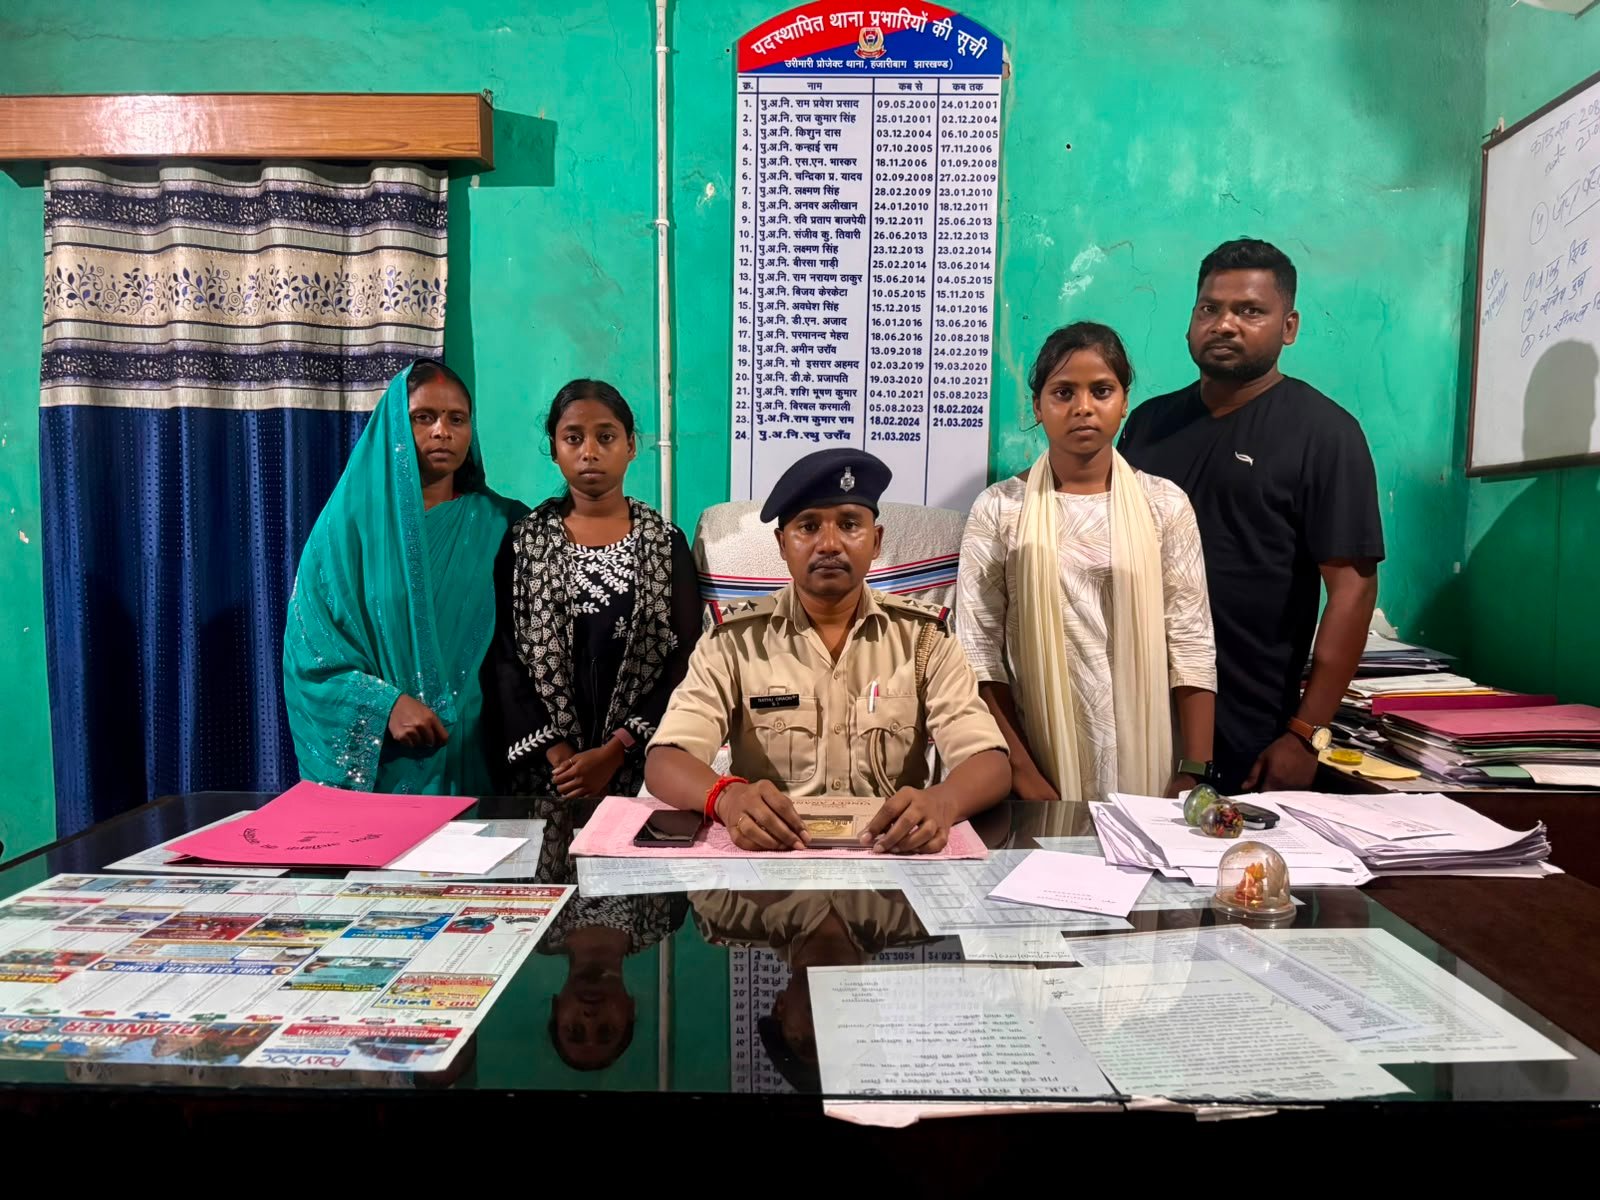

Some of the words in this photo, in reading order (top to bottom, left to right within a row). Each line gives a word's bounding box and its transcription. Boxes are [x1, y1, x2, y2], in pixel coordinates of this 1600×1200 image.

[750, 14, 824, 54] पदस्थापित
[830, 11, 864, 28] थाना
[869, 8, 928, 32] प्रभारियों
[932, 18, 953, 40] की
[958, 30, 988, 59] सूची
[784, 58, 814, 68] उरीमारी
[816, 58, 843, 68] प्रोजेक्ट
[846, 59, 868, 69] थाना,
[870, 58, 907, 68] हजारीबाग
[914, 58, 953, 70] झारखण्ड)
[742, 81, 754, 91] क्र.
[807, 82, 822, 91] नाम
[898, 82, 912, 91] कब
[914, 80, 923, 91] से
[952, 82, 966, 92] कब
[968, 82, 984, 92] तक
[744, 100, 752, 108] 1.
[761, 96, 793, 111] पु.अ.नि.
[796, 100, 810, 108] राम
[813, 97, 834, 108] प्रवेश
[836, 100, 860, 108] प्रसाद
[877, 100, 936, 109] 09.05.2000
[942, 100, 997, 109] 24.01.2001
[743, 114, 752, 122] 2.
[760, 111, 793, 125] पु.अ.नि.
[795, 114, 812, 122] राज
[814, 114, 838, 126] कुमार
[839, 112, 856, 123] सिंह
[876, 114, 931, 123] 25.01.2001
[942, 115, 997, 124] 02.12.2004
[743, 128, 752, 137] 3.
[760, 126, 792, 140] पु.अ.नि.
[795, 126, 822, 140] किशुन
[824, 129, 842, 137] दास
[877, 129, 932, 138] 03.12.2004
[942, 130, 998, 138] 06.10.2005
[760, 140, 792, 154] पु.अ.नि.
[795, 140, 821, 153] कन्हाई
[823, 144, 838, 152] राम
[876, 144, 933, 153] 07.10.2005
[941, 144, 992, 153] 17.11.2006
[742, 158, 752, 166] 5.
[760, 155, 792, 169] पु.अ.नि.
[795, 158, 827, 168] एस.एन.
[830, 158, 857, 166] भास्कर
[876, 158, 927, 167] 18.11.2006
[941, 159, 997, 168] 01.09.2008
[742, 172, 751, 180] 6.
[760, 170, 792, 183] पु.अ.नि.
[828, 173, 838, 181] प्र.
[840, 173, 863, 181] यादव
[876, 173, 933, 182] 02.09.2008
[940, 174, 996, 182] 27.02.2009
[742, 186, 751, 195] 7.
[759, 184, 792, 198] पु.अ.नि.
[794, 187, 821, 195] लक्ष्मण
[823, 184, 840, 196] सिंह
[875, 187, 931, 196] 28.02.2009
[939, 188, 992, 196] 23.01.2010
[742, 201, 751, 209] 8.
[759, 197, 791, 212] पु.अ.नि.
[794, 202, 820, 210] अनवर
[822, 199, 858, 210] अलीखान
[874, 202, 929, 211] 24.01.2010
[940, 202, 988, 211] 18.12.2011
[742, 216, 751, 224] 9.
[759, 213, 791, 227] पु.अ.नि.
[794, 213, 808, 224] रवि
[810, 216, 832, 224] प्रताप
[834, 214, 866, 225] बाजपेयी
[875, 216, 923, 225] 19.12.2011
[939, 217, 992, 226] 25.06.2013
[739, 230, 754, 238] 10.
[758, 228, 791, 241] पु.अ.नि.
[793, 228, 818, 239] संजीव
[820, 231, 833, 242] कु.
[835, 228, 861, 239] तिवारी
[874, 231, 928, 240] 26.06.2013
[938, 232, 989, 240] 22.12.2013
[740, 245, 752, 253] 11.
[758, 242, 791, 256] पु.अ.नि.
[793, 245, 820, 253] लक्ष्मण
[822, 241, 839, 255] सिंह
[874, 246, 924, 254] 23.12.2013
[938, 246, 992, 255] 23.02.2014
[739, 273, 752, 281] 13.
[758, 270, 790, 284] पु.अ.नि.
[792, 274, 807, 282] राम
[809, 274, 838, 282] नरायण
[840, 274, 863, 284] ठाकुर
[873, 274, 926, 284] 15.06.2014
[937, 276, 992, 284] 04.05.2015
[738, 316, 751, 324] 16.
[757, 312, 789, 327] पु.अ.नि.
[791, 314, 820, 326] डी.एन.
[872, 318, 923, 327] 16.01.2016
[936, 319, 988, 328] 13.06.2016
[738, 330, 751, 338] 17.
[756, 326, 788, 342] पु.अ.नि.
[791, 331, 827, 340] परमानन्द
[829, 329, 849, 341] मेहरा
[871, 332, 923, 342] 18.06.2016
[934, 333, 990, 342] 20.08.2018
[736, 373, 750, 381] 20.
[756, 369, 788, 384] पु.अ.नि.
[790, 371, 814, 382] डी.के.
[816, 372, 849, 383] प्रजापति
[870, 375, 923, 384] 19.03.2020
[934, 376, 988, 385] 04.10.2021
[736, 415, 750, 424] 23.
[811, 416, 837, 427] कुमार
[838, 416, 854, 424] राम
[870, 416, 920, 426] 18.02.2024
[933, 417, 983, 428] 21.03.2025
[735, 430, 750, 440] 24.
[871, 431, 921, 442] 21.03.2025
[112, 964, 158, 972] CLINIC
[162, 966, 208, 974] DENTAL
[61, 1022, 202, 1035] PLANNER
